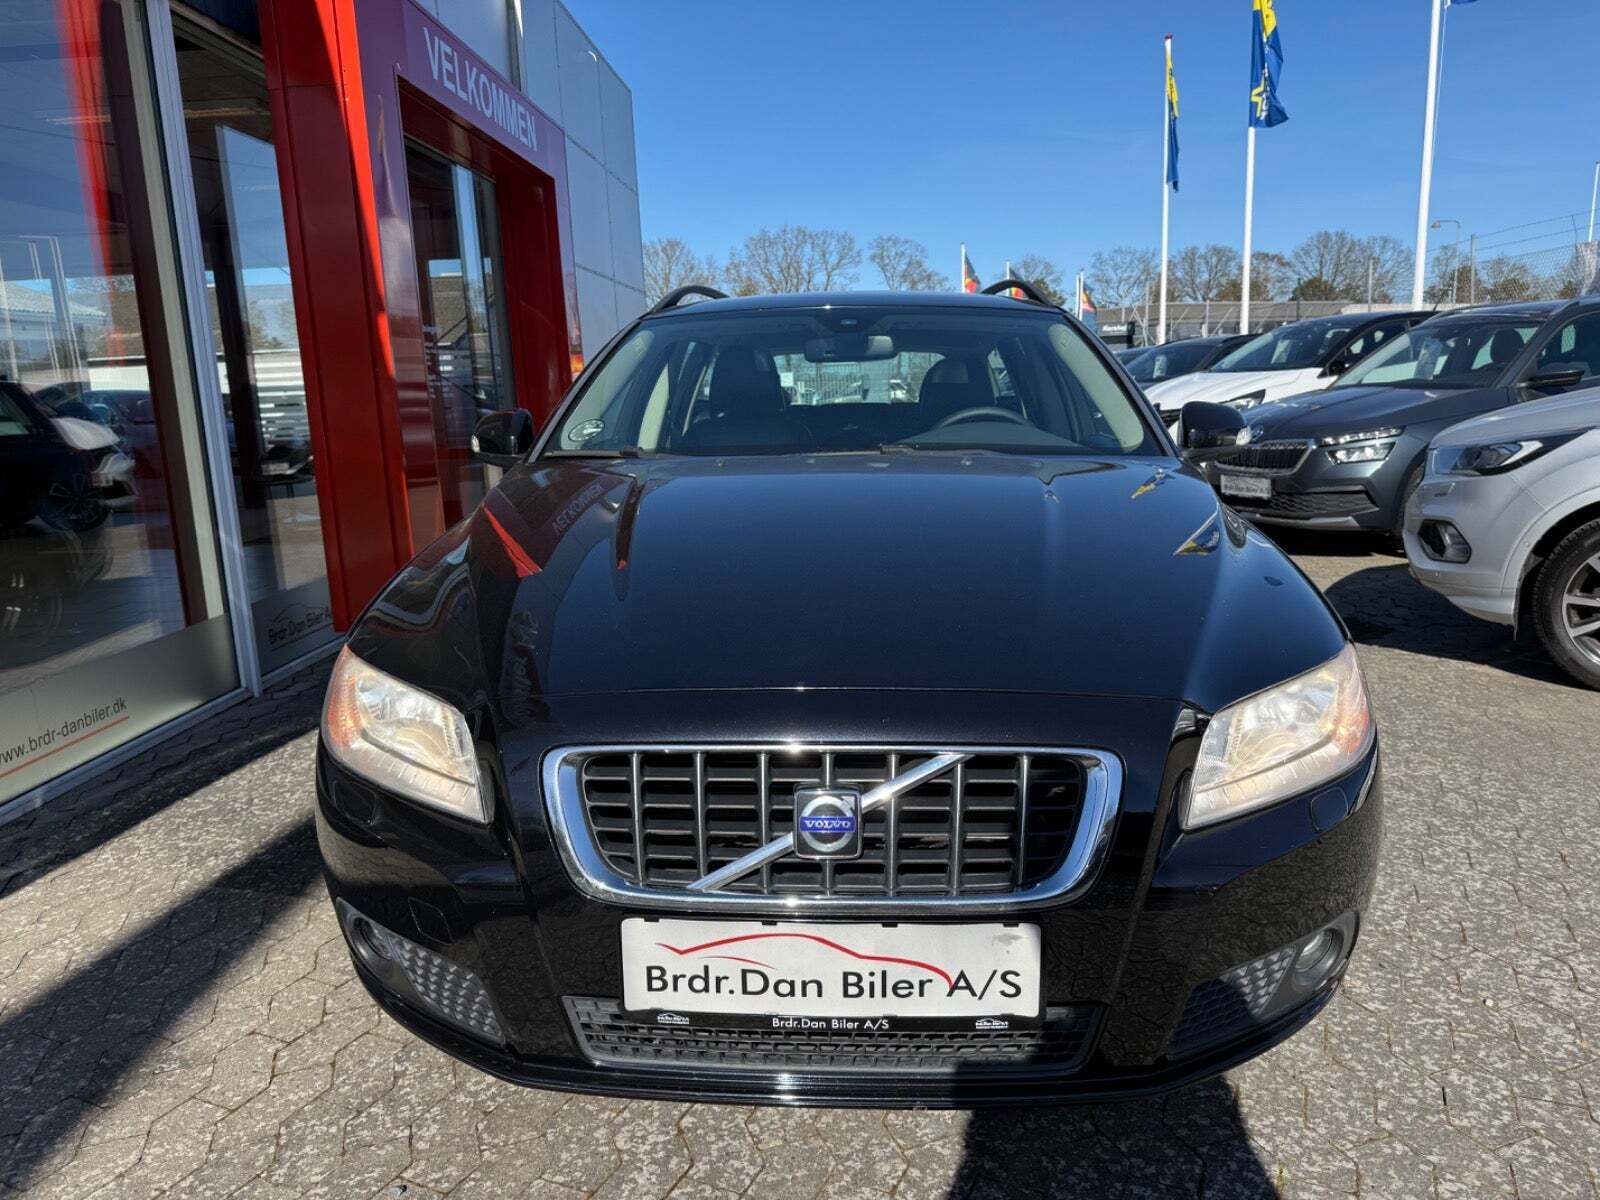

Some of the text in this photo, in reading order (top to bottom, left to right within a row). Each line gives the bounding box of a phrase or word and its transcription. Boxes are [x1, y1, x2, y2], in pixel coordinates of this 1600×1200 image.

[424, 27, 537, 152] VELKOMMEN
[0, 698, 127, 764] ww.brdr-danbiler.dk
[804, 819, 851, 829] VOLVO
[842, 969, 933, 999] Biler
[946, 969, 1022, 1000] A/S
[831, 1018, 859, 1029] Biler
[863, 1018, 889, 1030] A/S
